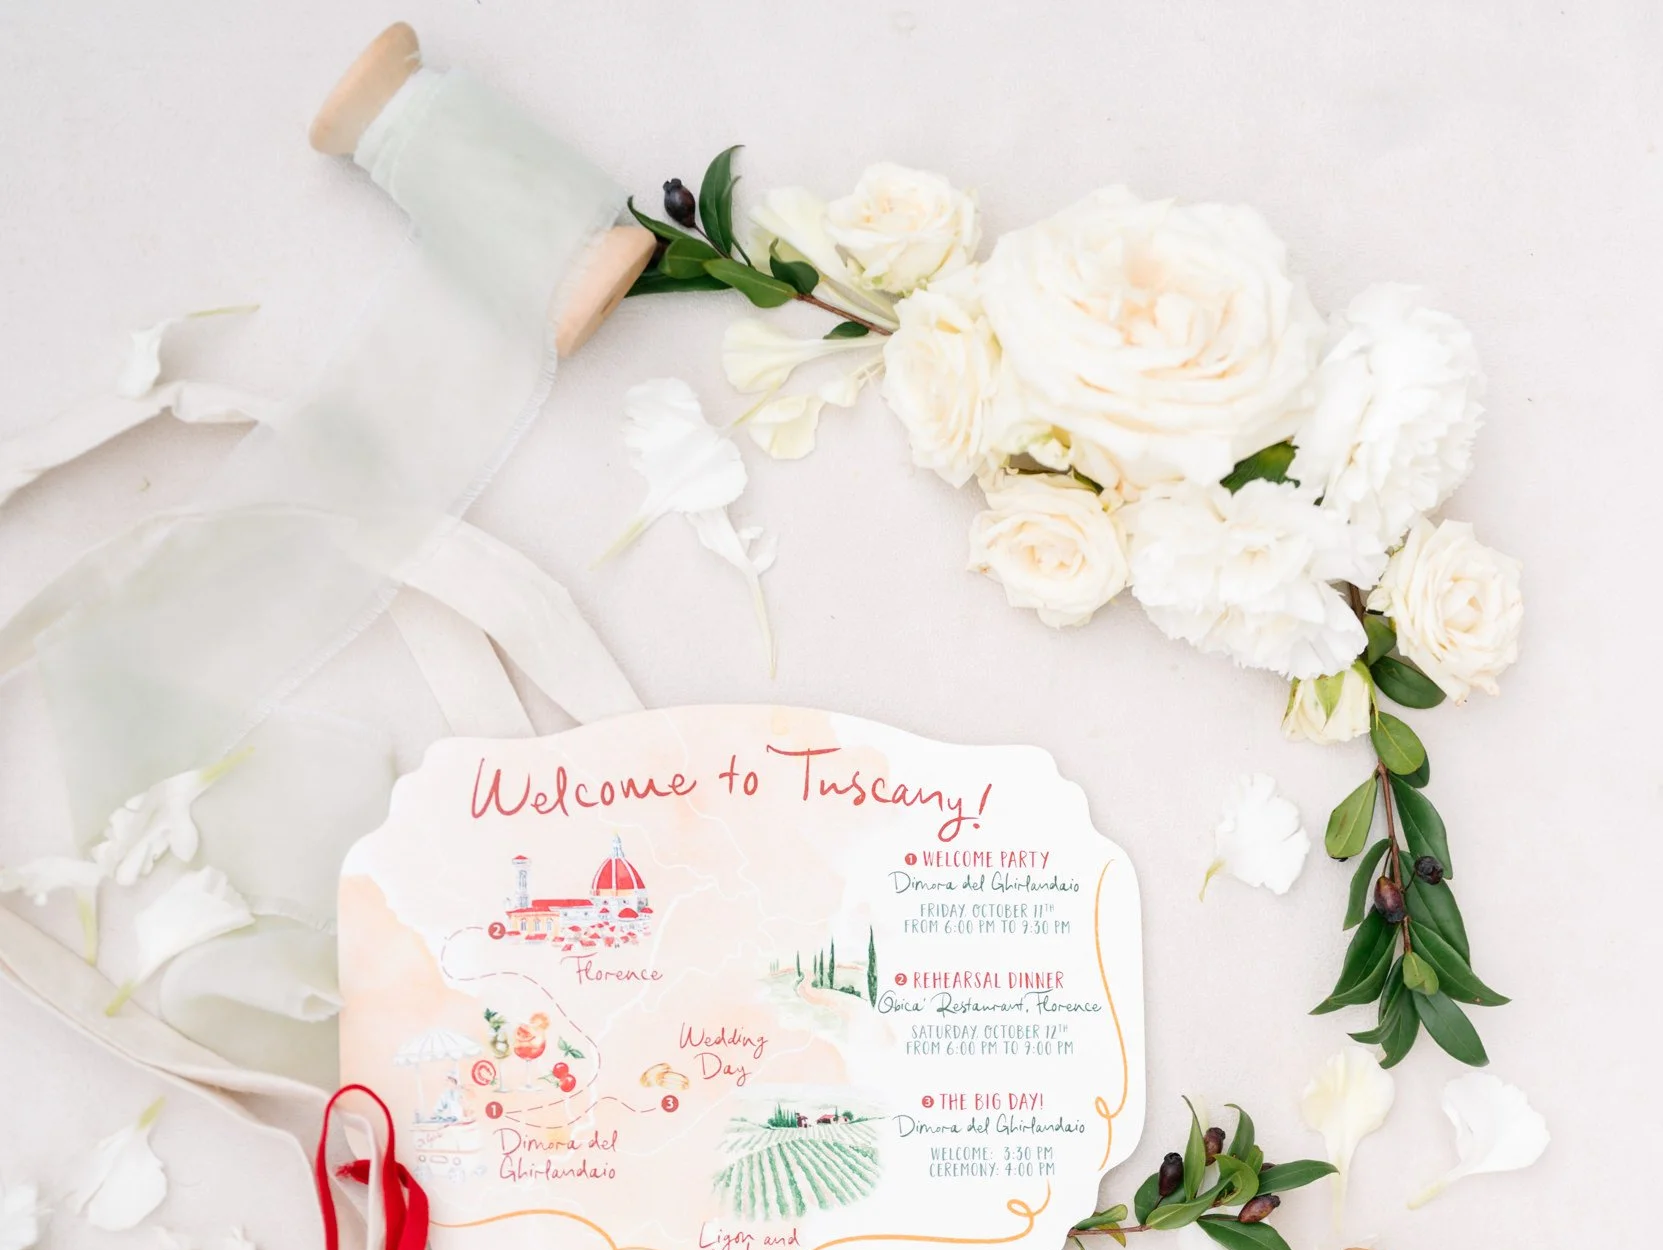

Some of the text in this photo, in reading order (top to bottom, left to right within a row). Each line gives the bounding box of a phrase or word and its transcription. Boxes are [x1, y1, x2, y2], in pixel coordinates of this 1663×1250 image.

[471, 744, 992, 843] Welcome to Tuscany!
[922, 850, 994, 868] WELCOME
[999, 850, 1050, 869] PARTY
[888, 870, 1080, 894] Dimora del Ghirlandaio
[972, 903, 1028, 919] OCTOBER
[904, 918, 1072, 935] FROM 6:00 PM TO 9:30 PM
[560, 952, 664, 985] Florence
[913, 971, 1002, 989] REHEARSAL
[1008, 971, 1065, 990] DINNER
[1022, 988, 1103, 1015] Florence
[678, 1022, 769, 1060] Wedding
[983, 1024, 1040, 1040] OCTOBER
[905, 1040, 1075, 1056] FROM 6:00 PM TO 9:00 PM
[693, 1052, 753, 1087] Day
[939, 1093, 967, 1110] THE
[974, 1093, 1002, 1110] BIG
[1008, 1093, 1044, 1111] DAY!
[892, 1113, 1086, 1138] Dimora del Ghirlandaio
[492, 1127, 618, 1156] Dimora del
[930, 1146, 1053, 1162] WELCOME: 3:30 PM
[499, 1151, 616, 1182] Ghirlandaio
[929, 1162, 1056, 1178] CEREMONY: 4:00 PM
[763, 1227, 801, 1247] and
